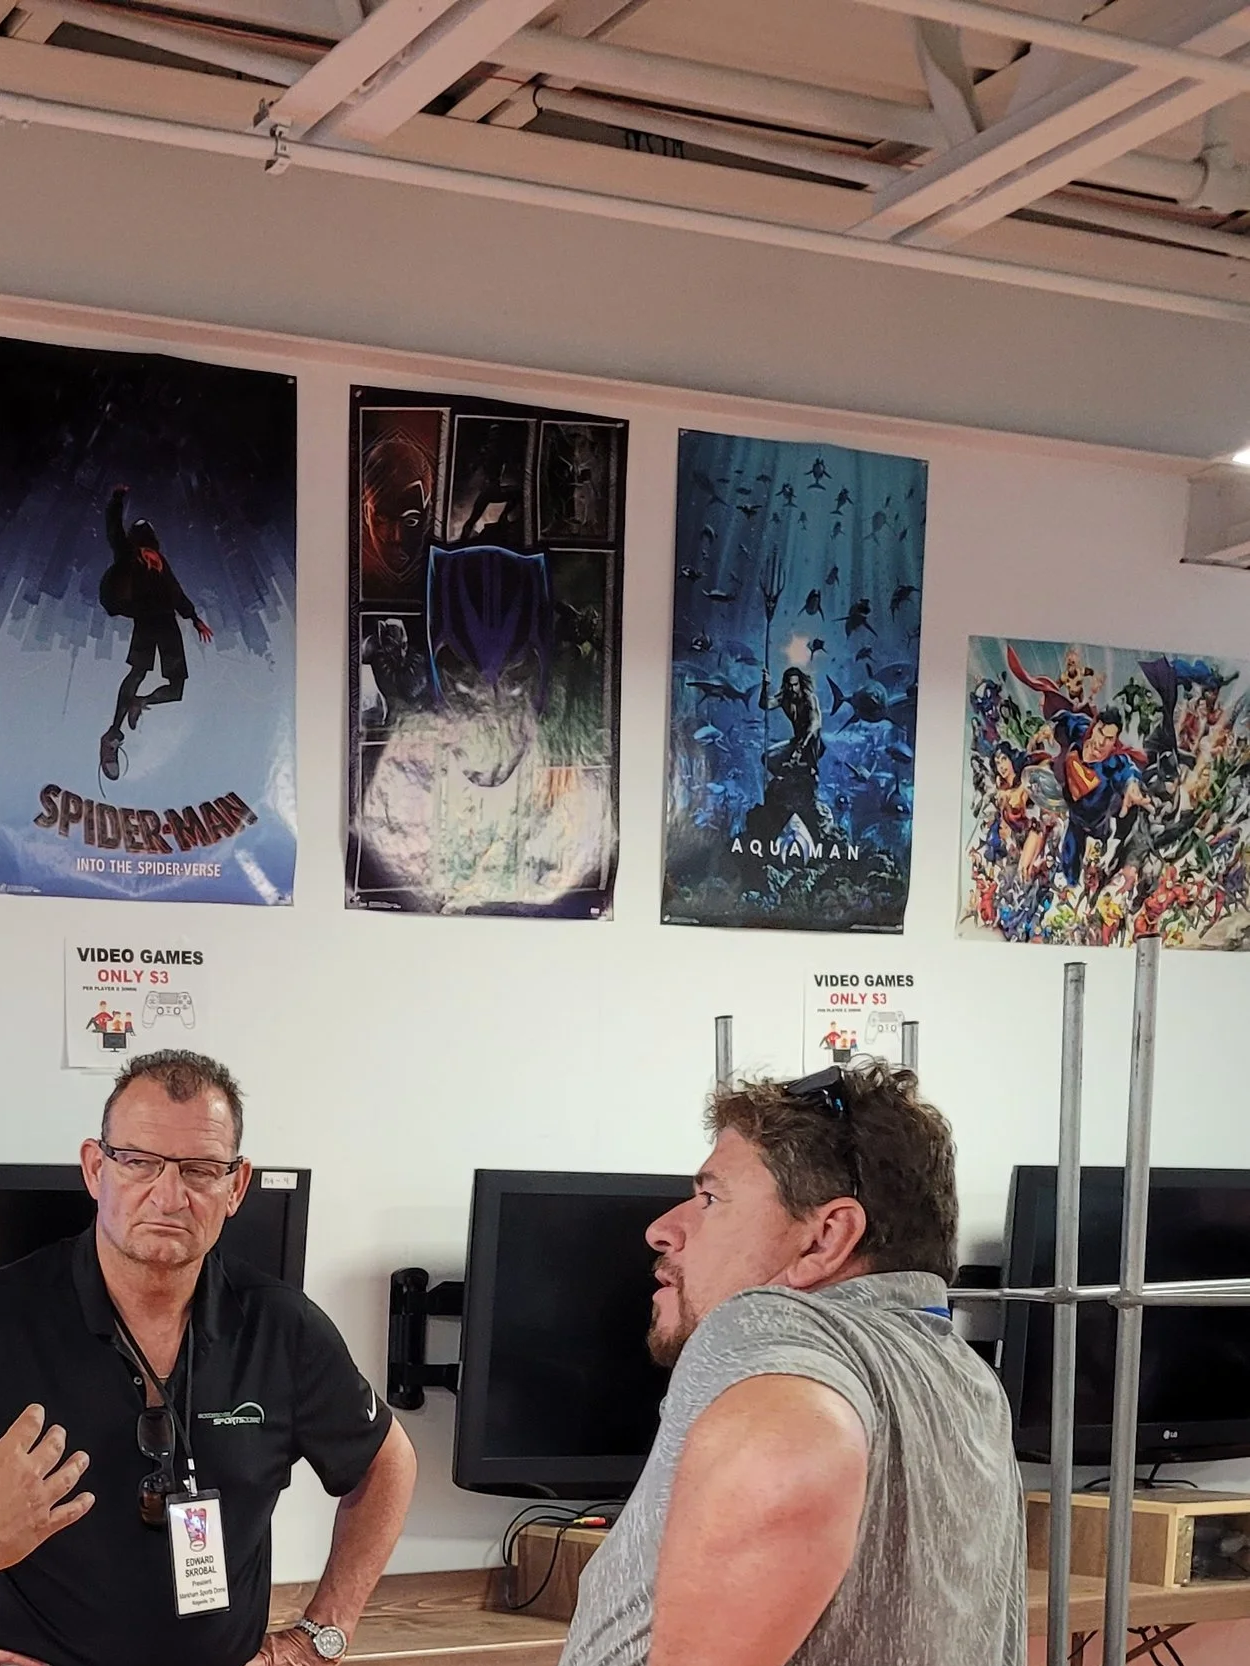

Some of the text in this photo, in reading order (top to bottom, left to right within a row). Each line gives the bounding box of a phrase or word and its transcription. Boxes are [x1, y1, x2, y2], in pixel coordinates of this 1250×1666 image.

[33, 784, 258, 854] SPIDER-MAN
[731, 838, 860, 861] AQUAMAN
[76, 858, 222, 877] INTO THE SPIDER-VERSE
[76, 947, 203, 965] VIDEO GAMES
[97, 969, 144, 983] ONLY
[814, 974, 914, 987] VIDEO GAMES
[830, 993, 867, 1005] ONLY
[185, 1555, 214, 1567] EDWARD
[185, 1565, 217, 1578] SKROBAL
